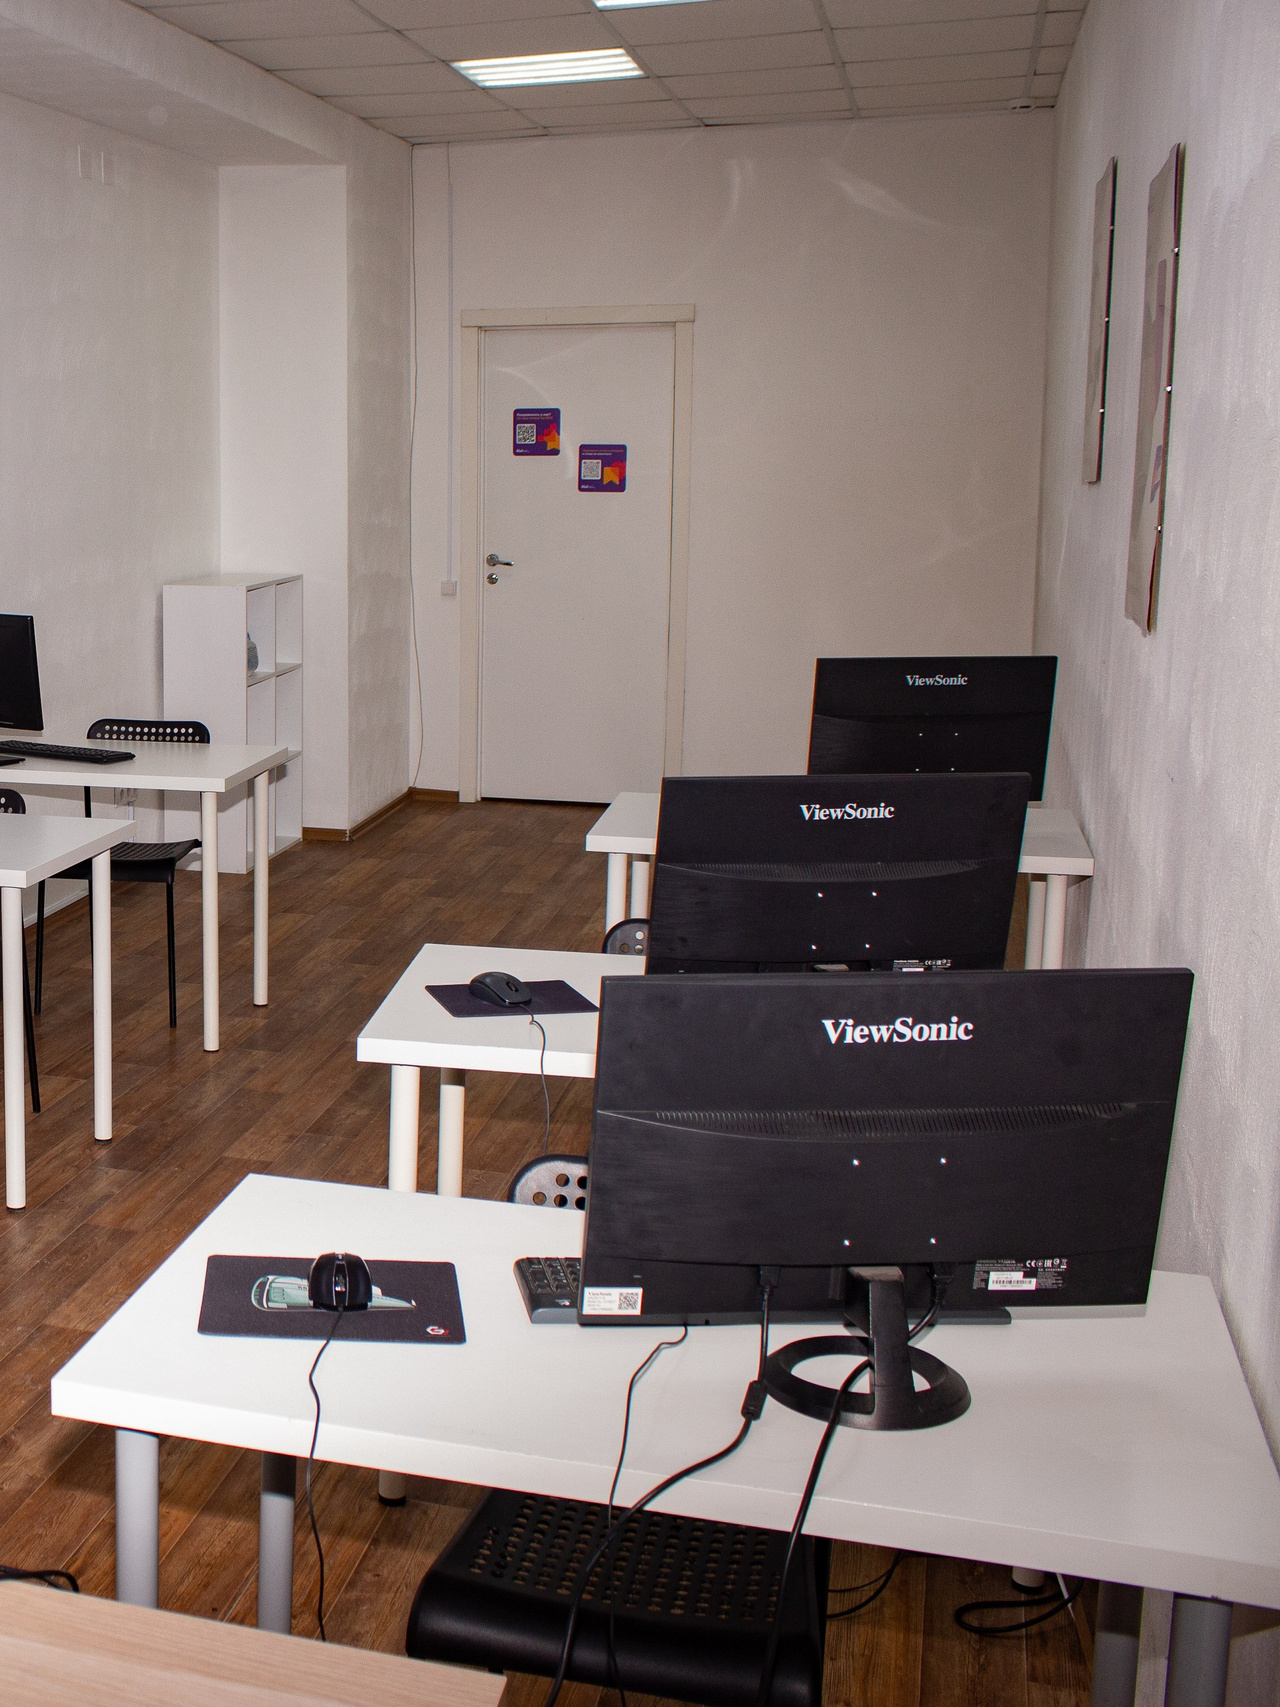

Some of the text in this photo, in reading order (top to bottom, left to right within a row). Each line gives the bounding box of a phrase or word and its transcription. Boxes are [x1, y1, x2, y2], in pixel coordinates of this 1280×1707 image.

[906, 674, 968, 687] ViewSonic
[799, 803, 895, 821] ViewSonic
[821, 1015, 975, 1044] ViewSonic
